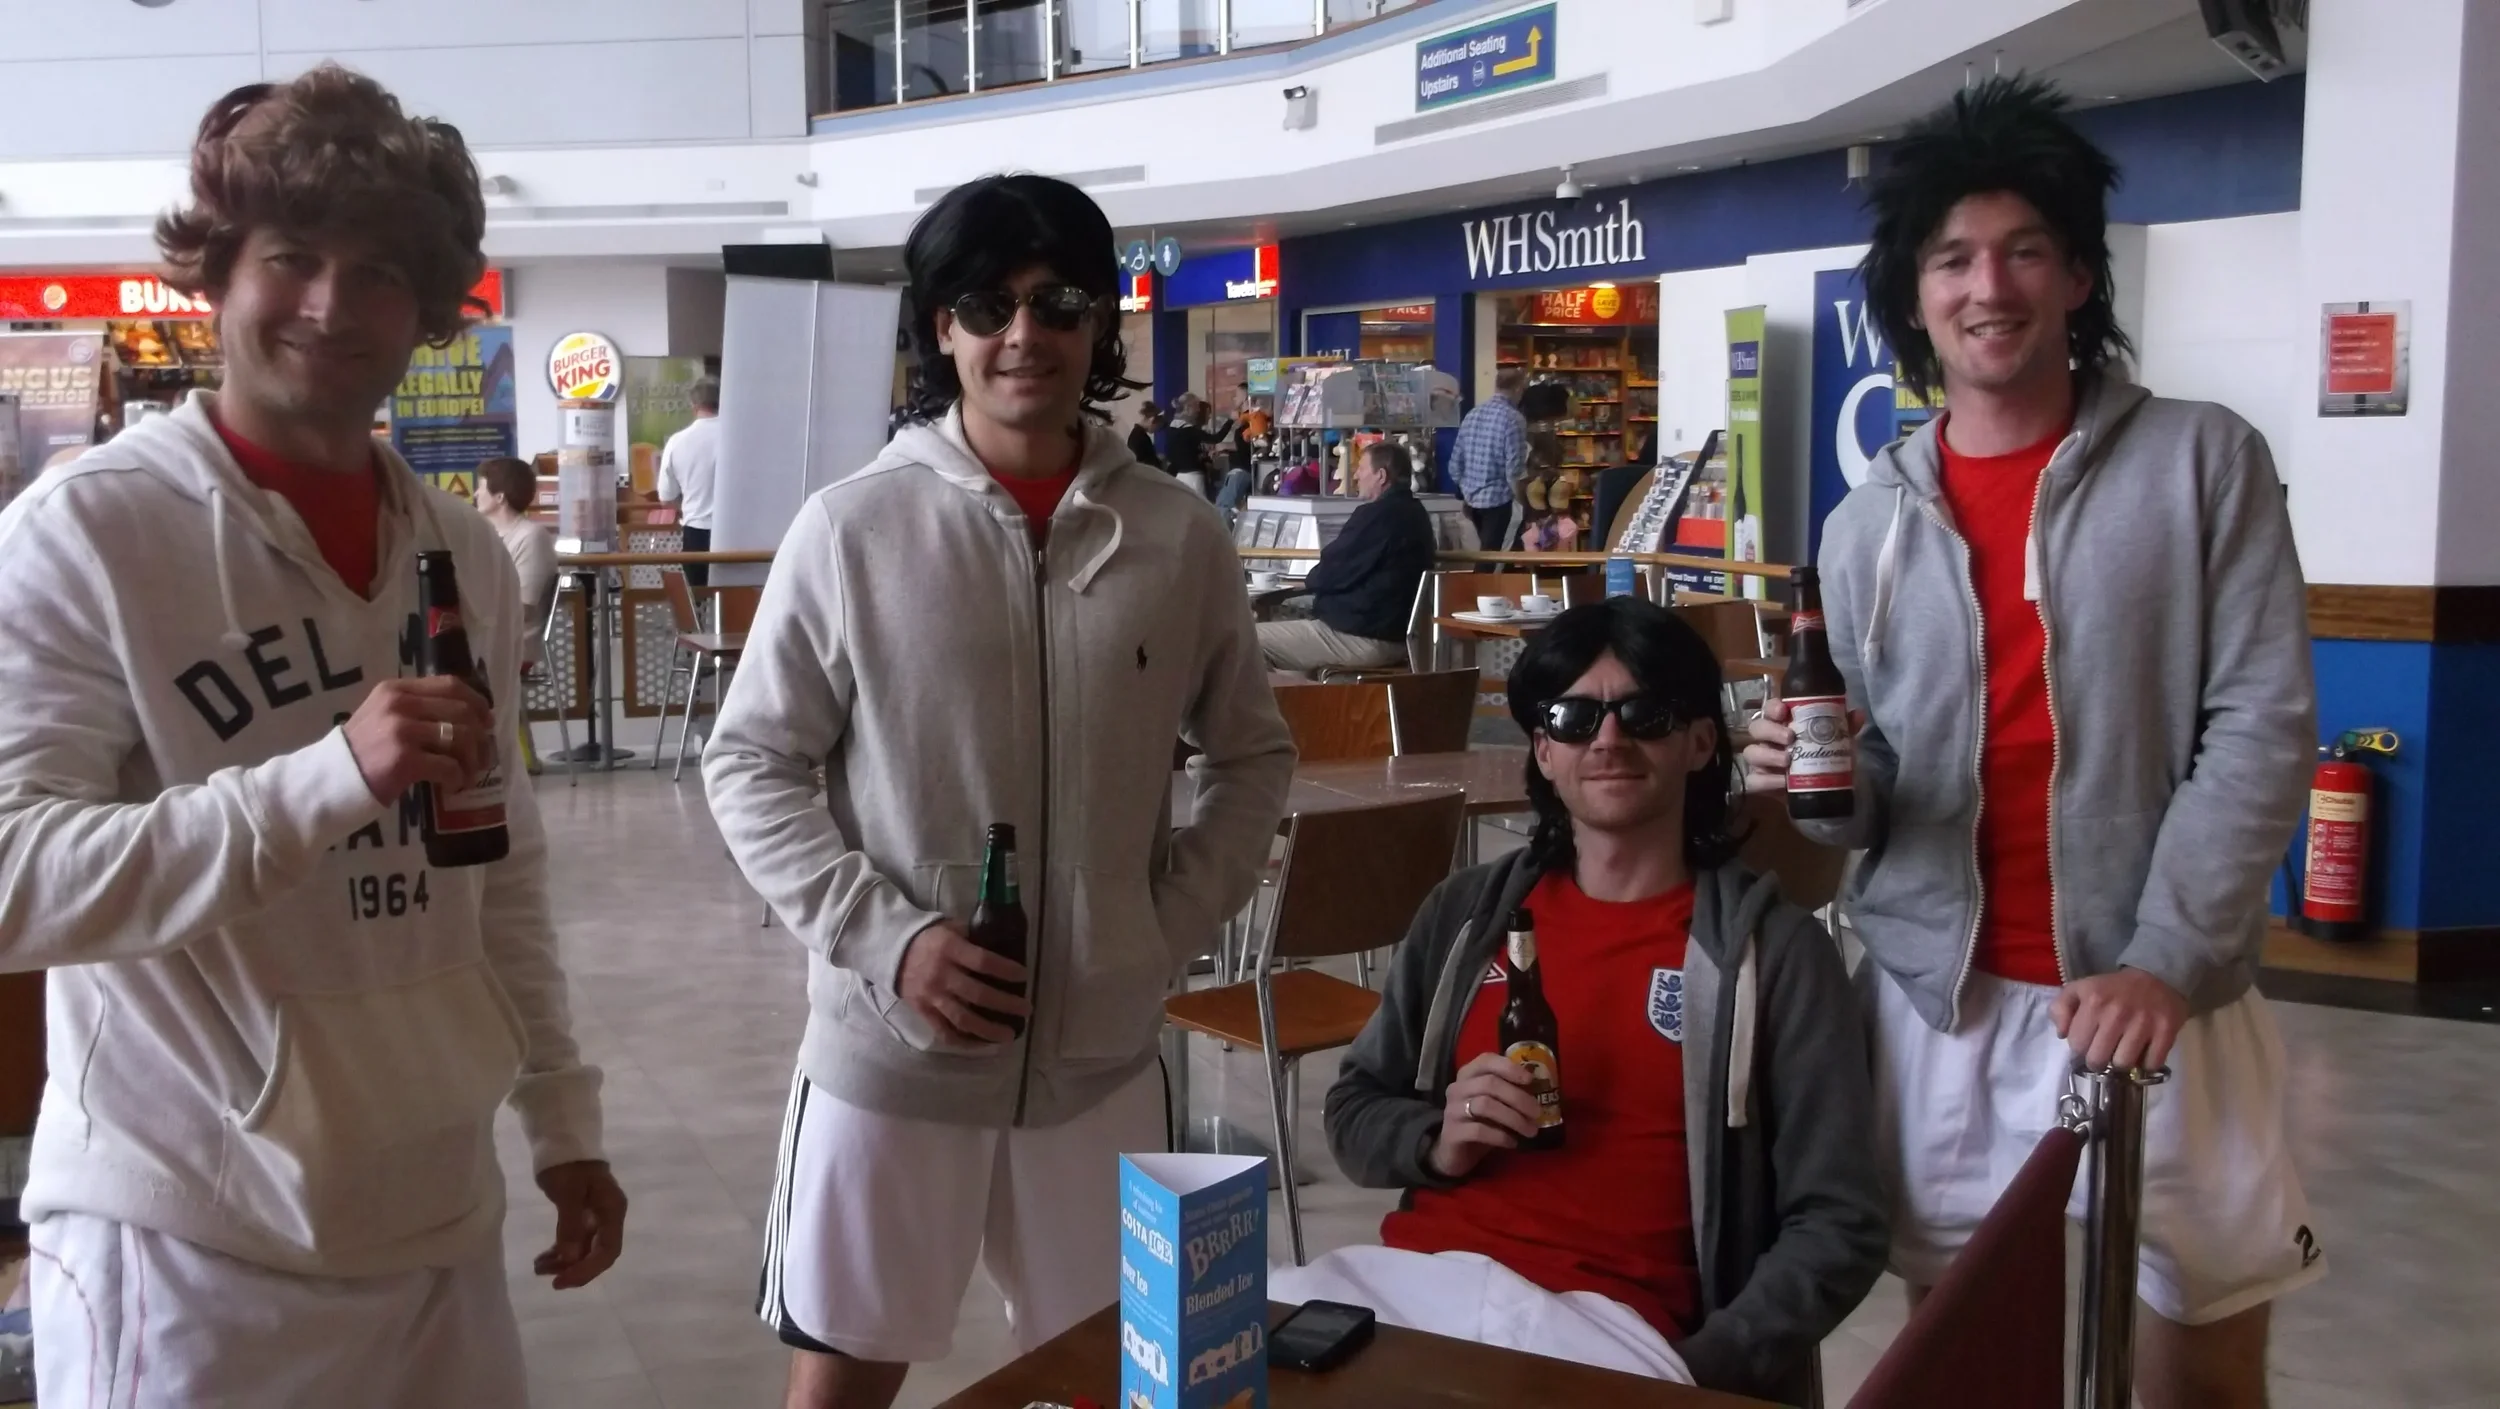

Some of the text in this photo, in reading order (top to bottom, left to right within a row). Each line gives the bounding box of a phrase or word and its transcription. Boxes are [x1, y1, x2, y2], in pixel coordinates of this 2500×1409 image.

[1421, 34, 1507, 71] Additional Seating
[1421, 75, 1459, 100] Upstairs
[1462, 198, 1646, 280] WHSmith
[1541, 292, 1587, 308] HALF
[1544, 307, 1581, 318] PRICE
[410, 335, 483, 368] RIVE
[553, 345, 608, 373] BURGER
[557, 358, 611, 393] KING
[397, 397, 485, 418] IN EUROPE!
[173, 618, 363, 742] DEL
[349, 869, 430, 921] 1964
[1122, 1208, 1148, 1245] COSTA
[1148, 1230, 1173, 1264] ICE
[2294, 1224, 2321, 1269] 2
[1136, 1270, 1148, 1296] Ice
[1185, 1278, 1235, 1316] Blended
[1238, 1273, 1254, 1293] Ice
